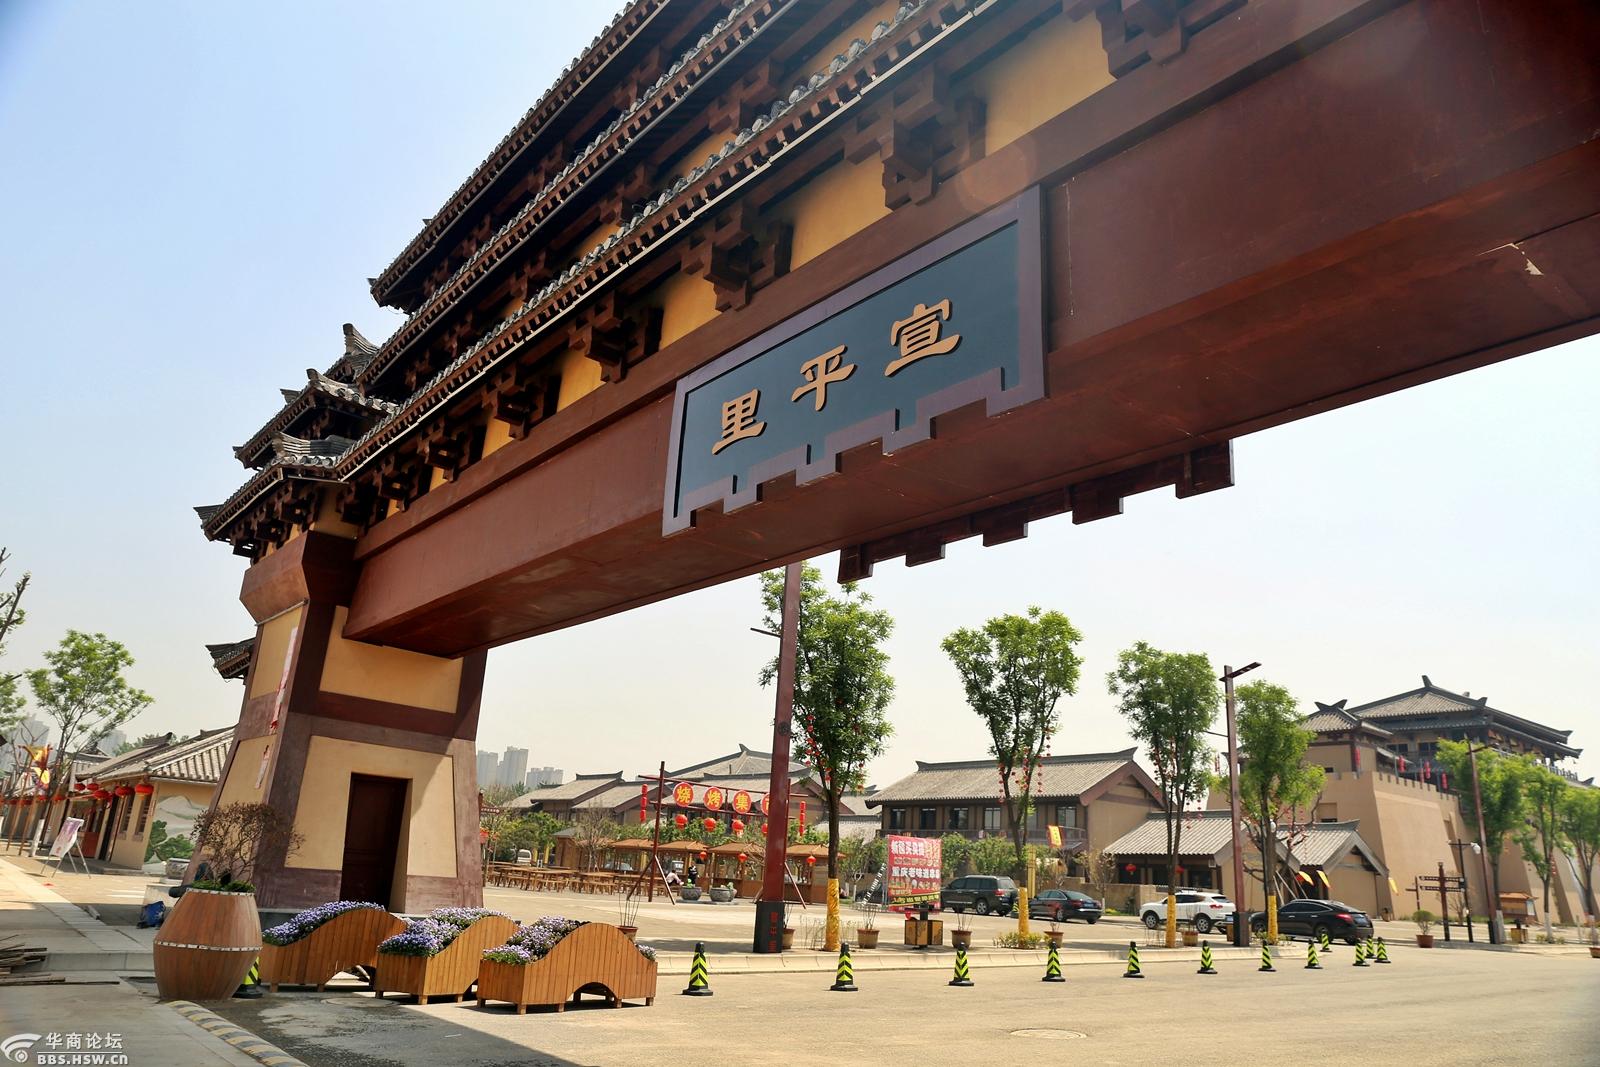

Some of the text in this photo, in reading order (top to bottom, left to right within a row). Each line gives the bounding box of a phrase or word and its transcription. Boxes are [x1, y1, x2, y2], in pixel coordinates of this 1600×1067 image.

[711, 298, 961, 456] 宣平里
[676, 785, 769, 812] 烧烤集
